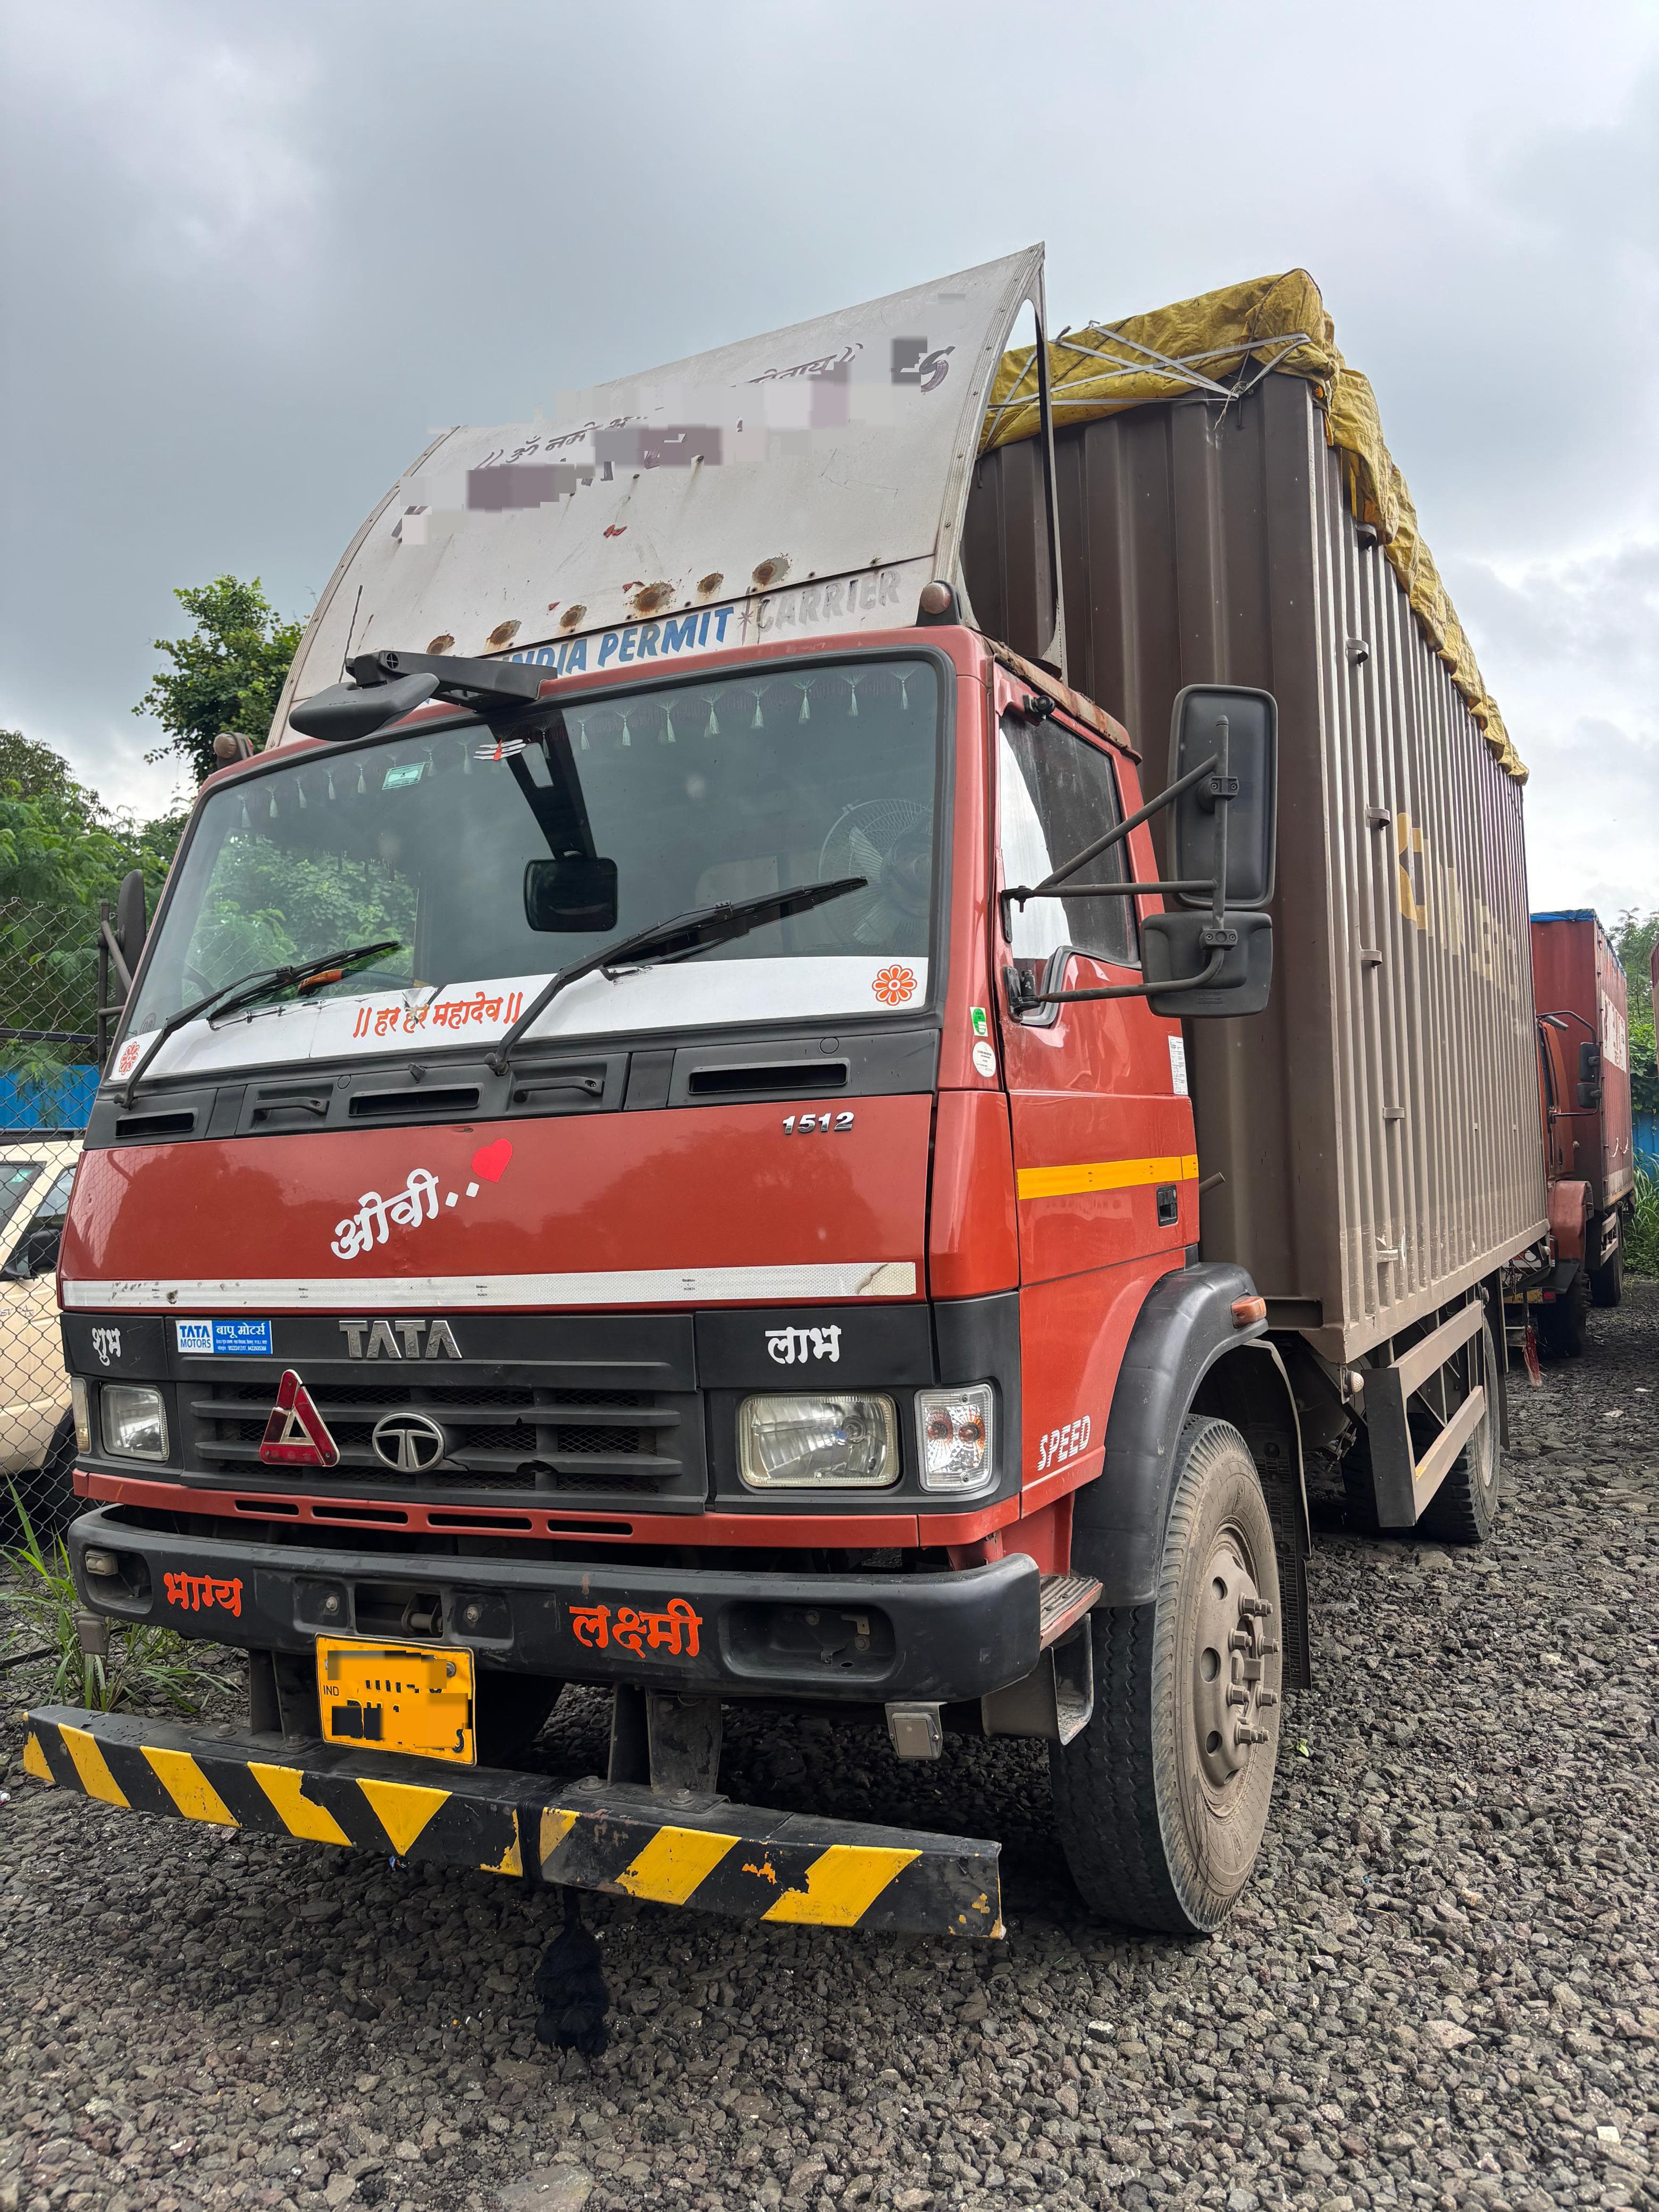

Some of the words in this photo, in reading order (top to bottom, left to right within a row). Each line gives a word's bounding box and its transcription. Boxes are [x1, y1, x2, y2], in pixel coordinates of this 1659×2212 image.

[502, 639, 587, 676] DIA
[598, 606, 734, 667] PERMIT
[757, 570, 901, 632] CARRIER
[374, 1007, 401, 1036] हर
[432, 991, 504, 1029] महादेव
[783, 1111, 854, 1134] 1512
[91, 1327, 121, 1366] शुभ
[179, 1326, 210, 1338] TATA
[180, 1339, 211, 1348] MOTORS
[216, 1326, 238, 1338] बापू
[238, 1322, 265, 1335] मोटर्स
[339, 1320, 463, 1359] TATA
[765, 1325, 842, 1364] लाभ
[1037, 1415, 1091, 1471] SPEED
[163, 1571, 244, 1618] भाग्य
[569, 1598, 702, 1658] लक्ष्मी
[323, 1685, 339, 1696] IND
